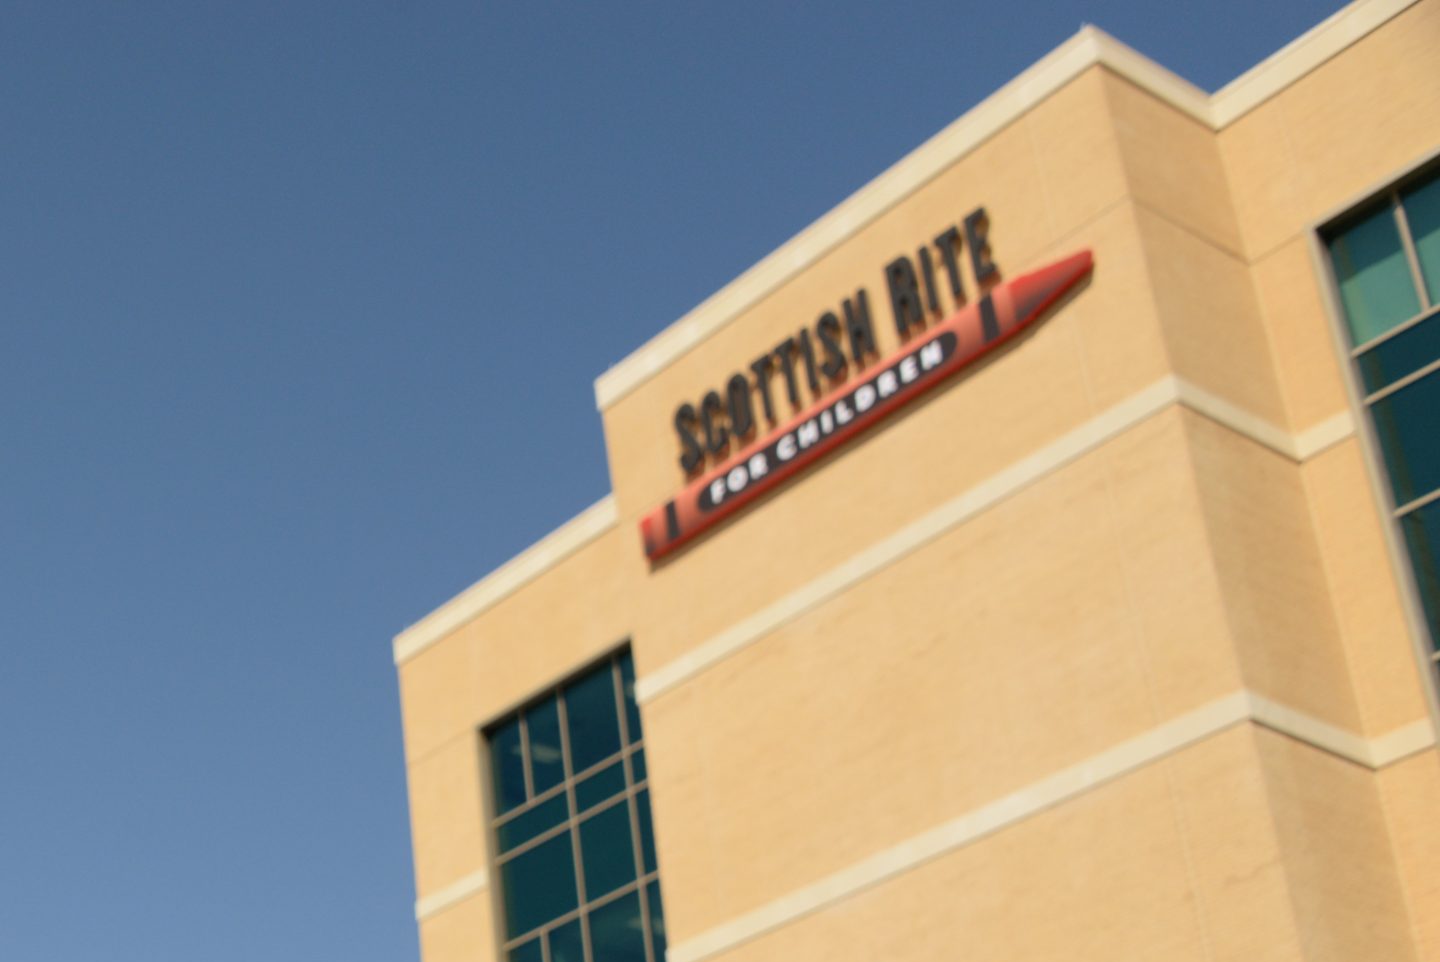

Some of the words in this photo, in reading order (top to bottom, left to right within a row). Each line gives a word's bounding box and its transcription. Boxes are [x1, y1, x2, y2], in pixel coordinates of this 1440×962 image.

[675, 287, 877, 474] SCOTTISH
[885, 207, 999, 336] RITE
[710, 452, 769, 505] FOR
[775, 339, 945, 462] CHILDREN
